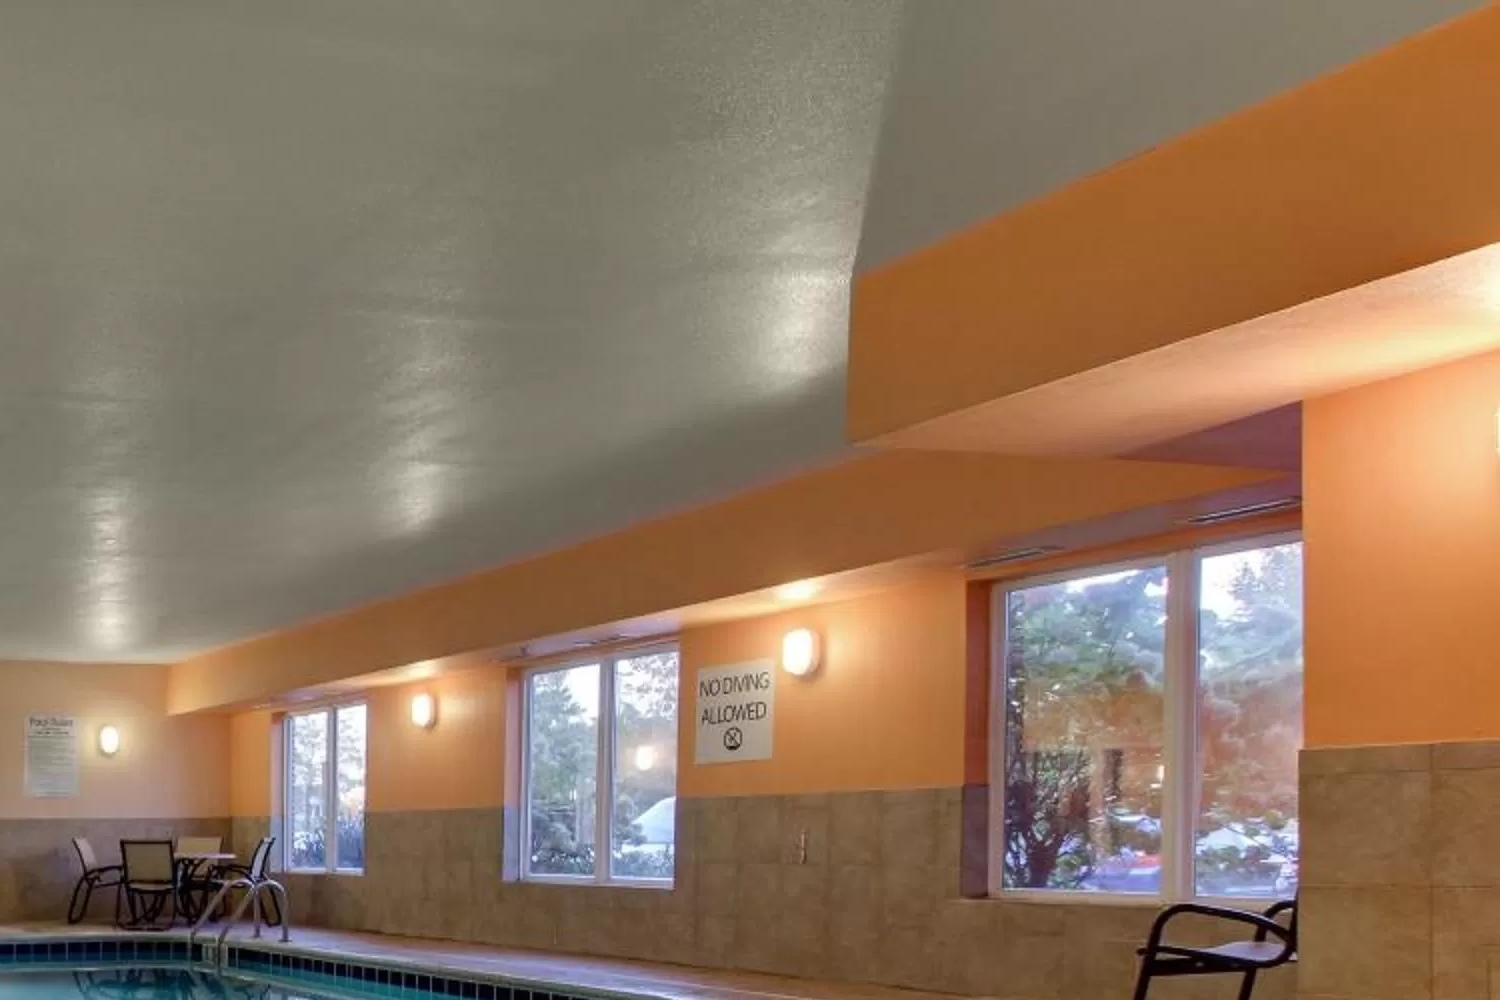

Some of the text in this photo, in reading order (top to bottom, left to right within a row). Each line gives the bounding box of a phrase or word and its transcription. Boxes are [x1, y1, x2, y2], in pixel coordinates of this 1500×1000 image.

[699, 671, 770, 697] NO DIVING
[701, 701, 766, 725] ALLOWED
